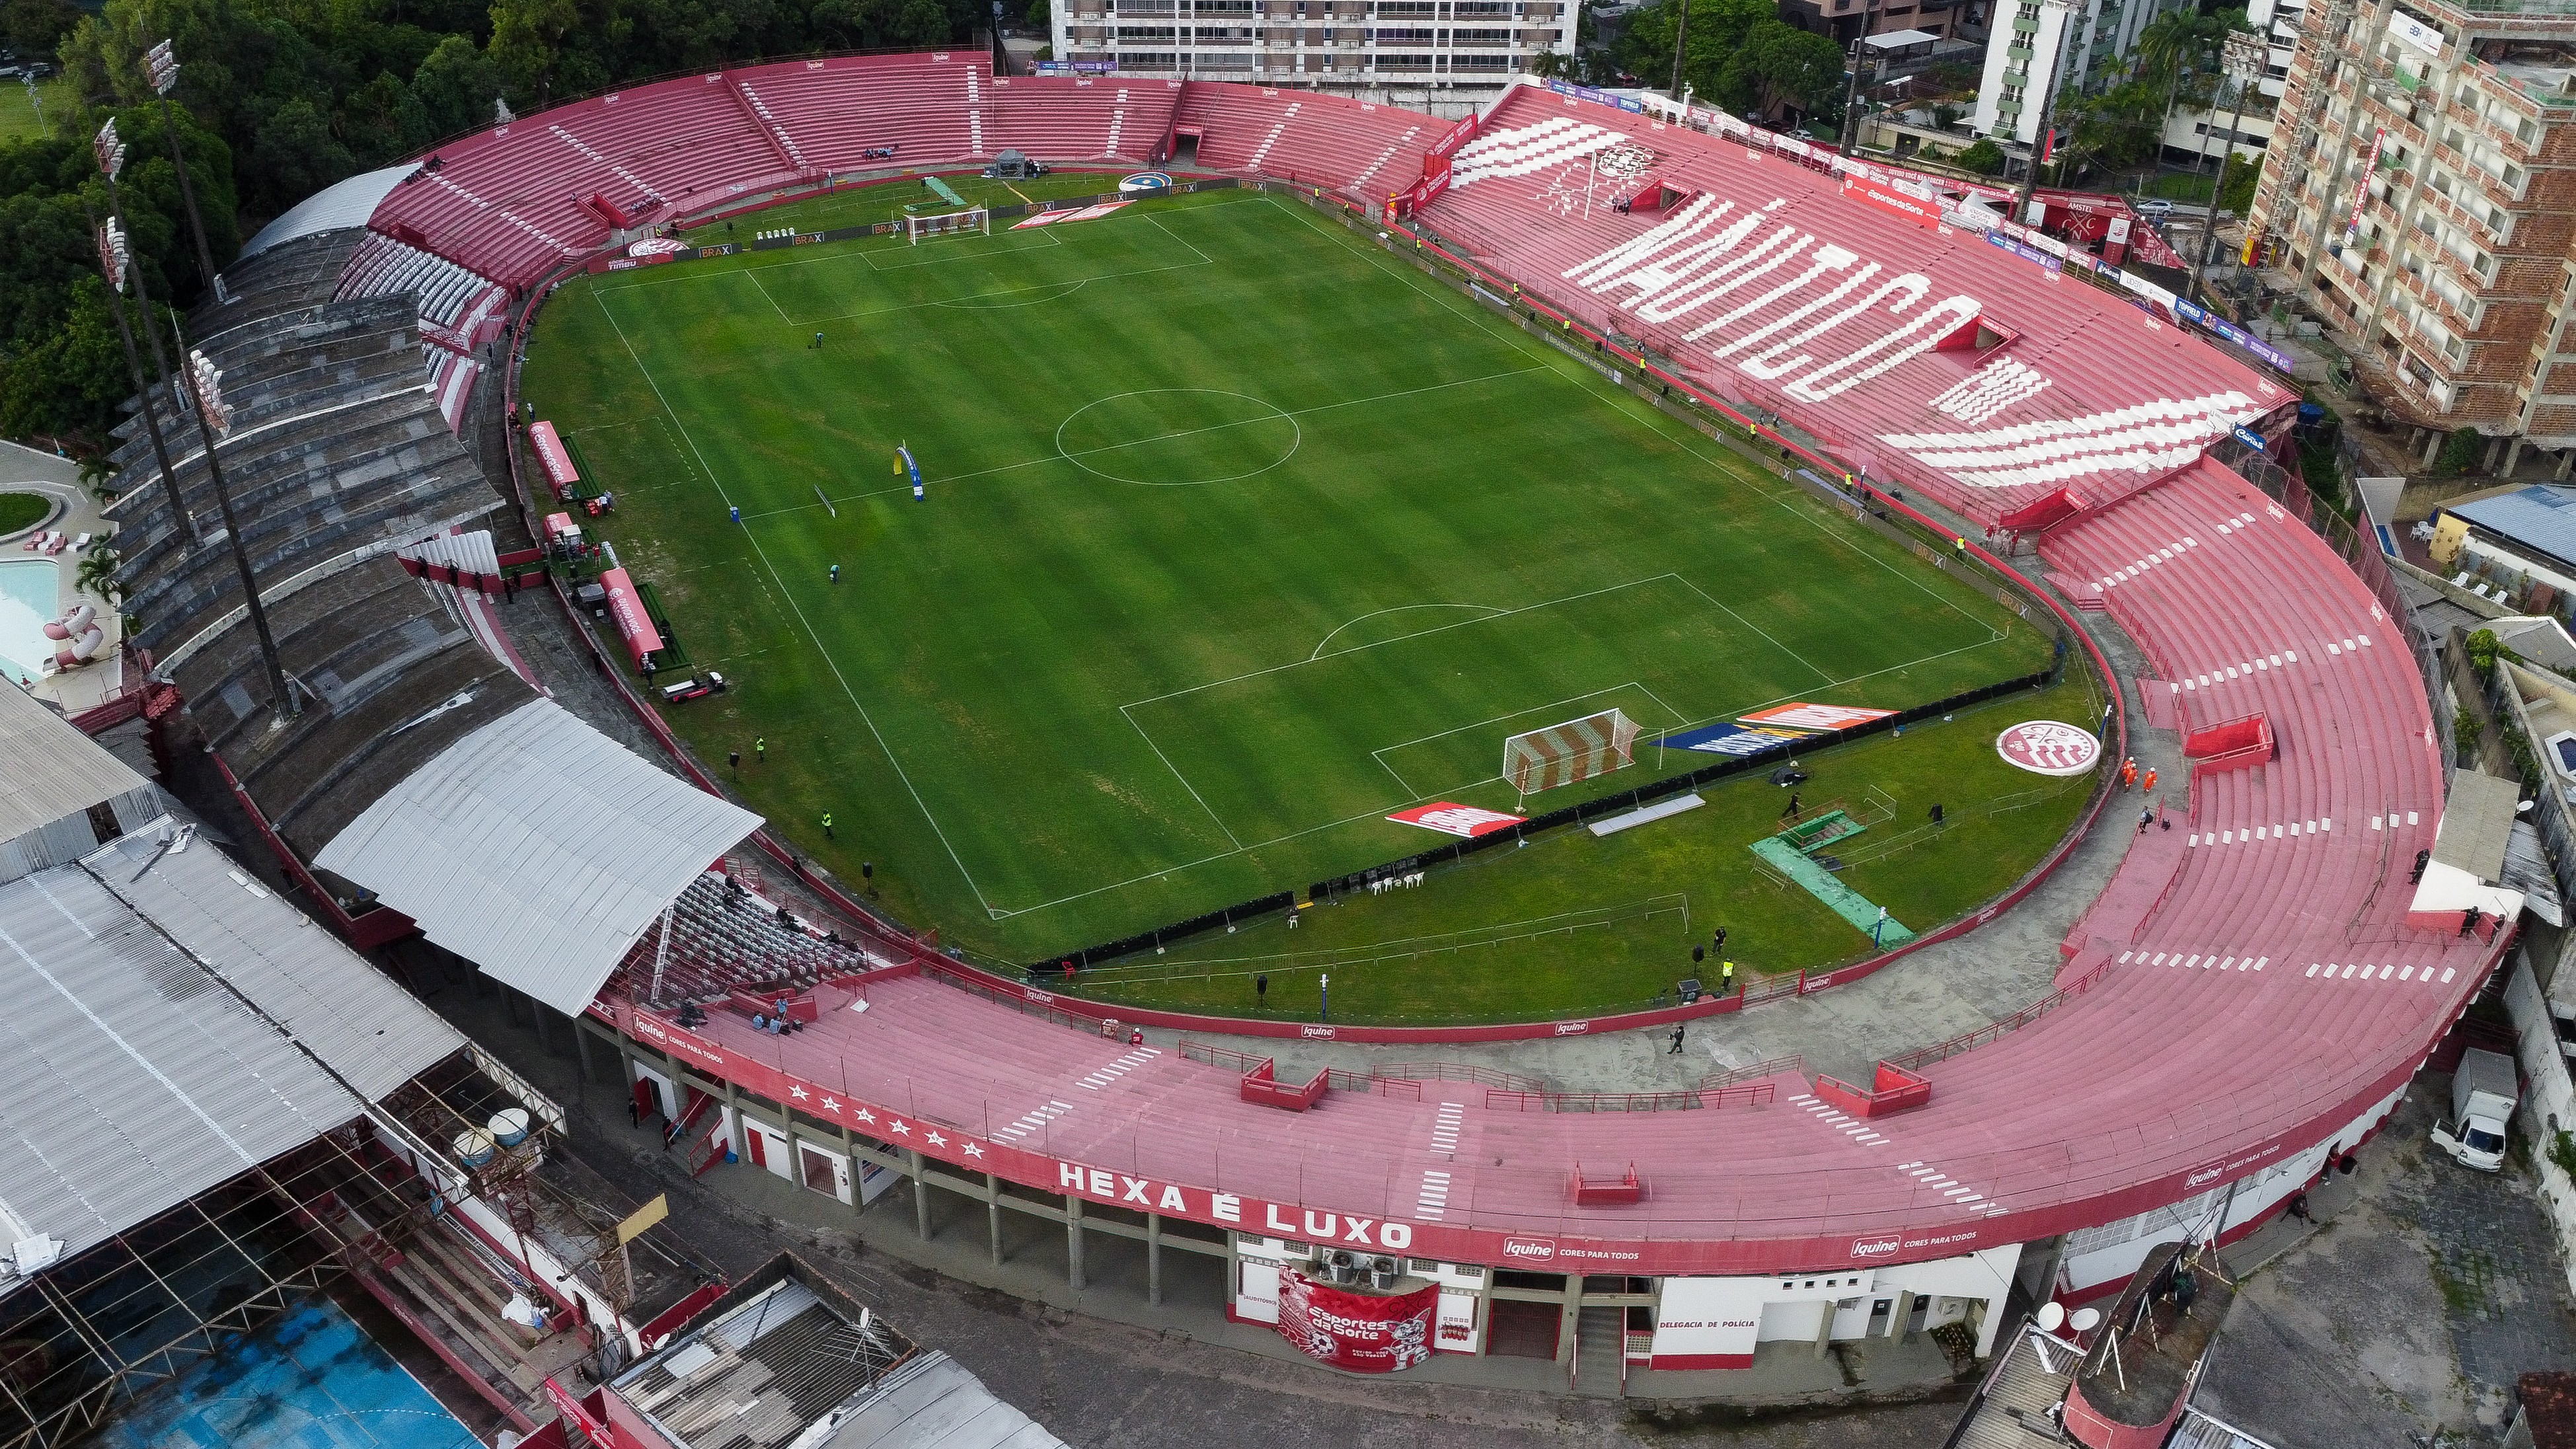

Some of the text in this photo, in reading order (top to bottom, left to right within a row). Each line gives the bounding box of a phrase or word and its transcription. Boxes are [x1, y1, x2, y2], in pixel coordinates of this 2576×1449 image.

[1620, 98, 1640, 109] TOPFIELD
[1171, 183, 1195, 194] BRAX
[1240, 180, 1264, 191] BRAX
[1101, 193, 1124, 203] BRAX
[1028, 203, 1052, 213] BRAX
[2067, 202, 2094, 213] AMSTEL
[874, 222, 900, 233] BRAX
[795, 233, 821, 245] BRAX
[702, 246, 730, 258] BRAX
[608, 261, 637, 271] TIMBU
[2178, 301, 2201, 318] TOPFIELD
[1916, 545, 1944, 569] BRAX
[1999, 594, 2028, 620] BRAX
[617, 597, 644, 636] DUVIDO VOCÊ
[1803, 977, 1830, 991] Iquine
[1026, 989, 1053, 1003] Iquine
[636, 1016, 664, 1039] Iquine
[1303, 1026, 1333, 1038] Iquine
[1557, 1022, 1586, 1035] Iquine
[669, 1035, 723, 1064] CORES PARA TODOS
[2225, 1144, 2280, 1172] CORES PARA TODOS
[2187, 1167, 2221, 1187] Iquine
[1059, 1162, 1412, 1249] HEXA É LUXO
[1904, 1231, 1977, 1248] CORES PARA TODOS
[1505, 1240, 1552, 1257] Iquine
[1560, 1248, 1639, 1260] CORES PARA TODOS
[1853, 1240, 1897, 1256] Iquine
[1312, 1318, 1379, 1341] da Sorte
[1722, 1318, 1755, 1328] POLÍCIA
